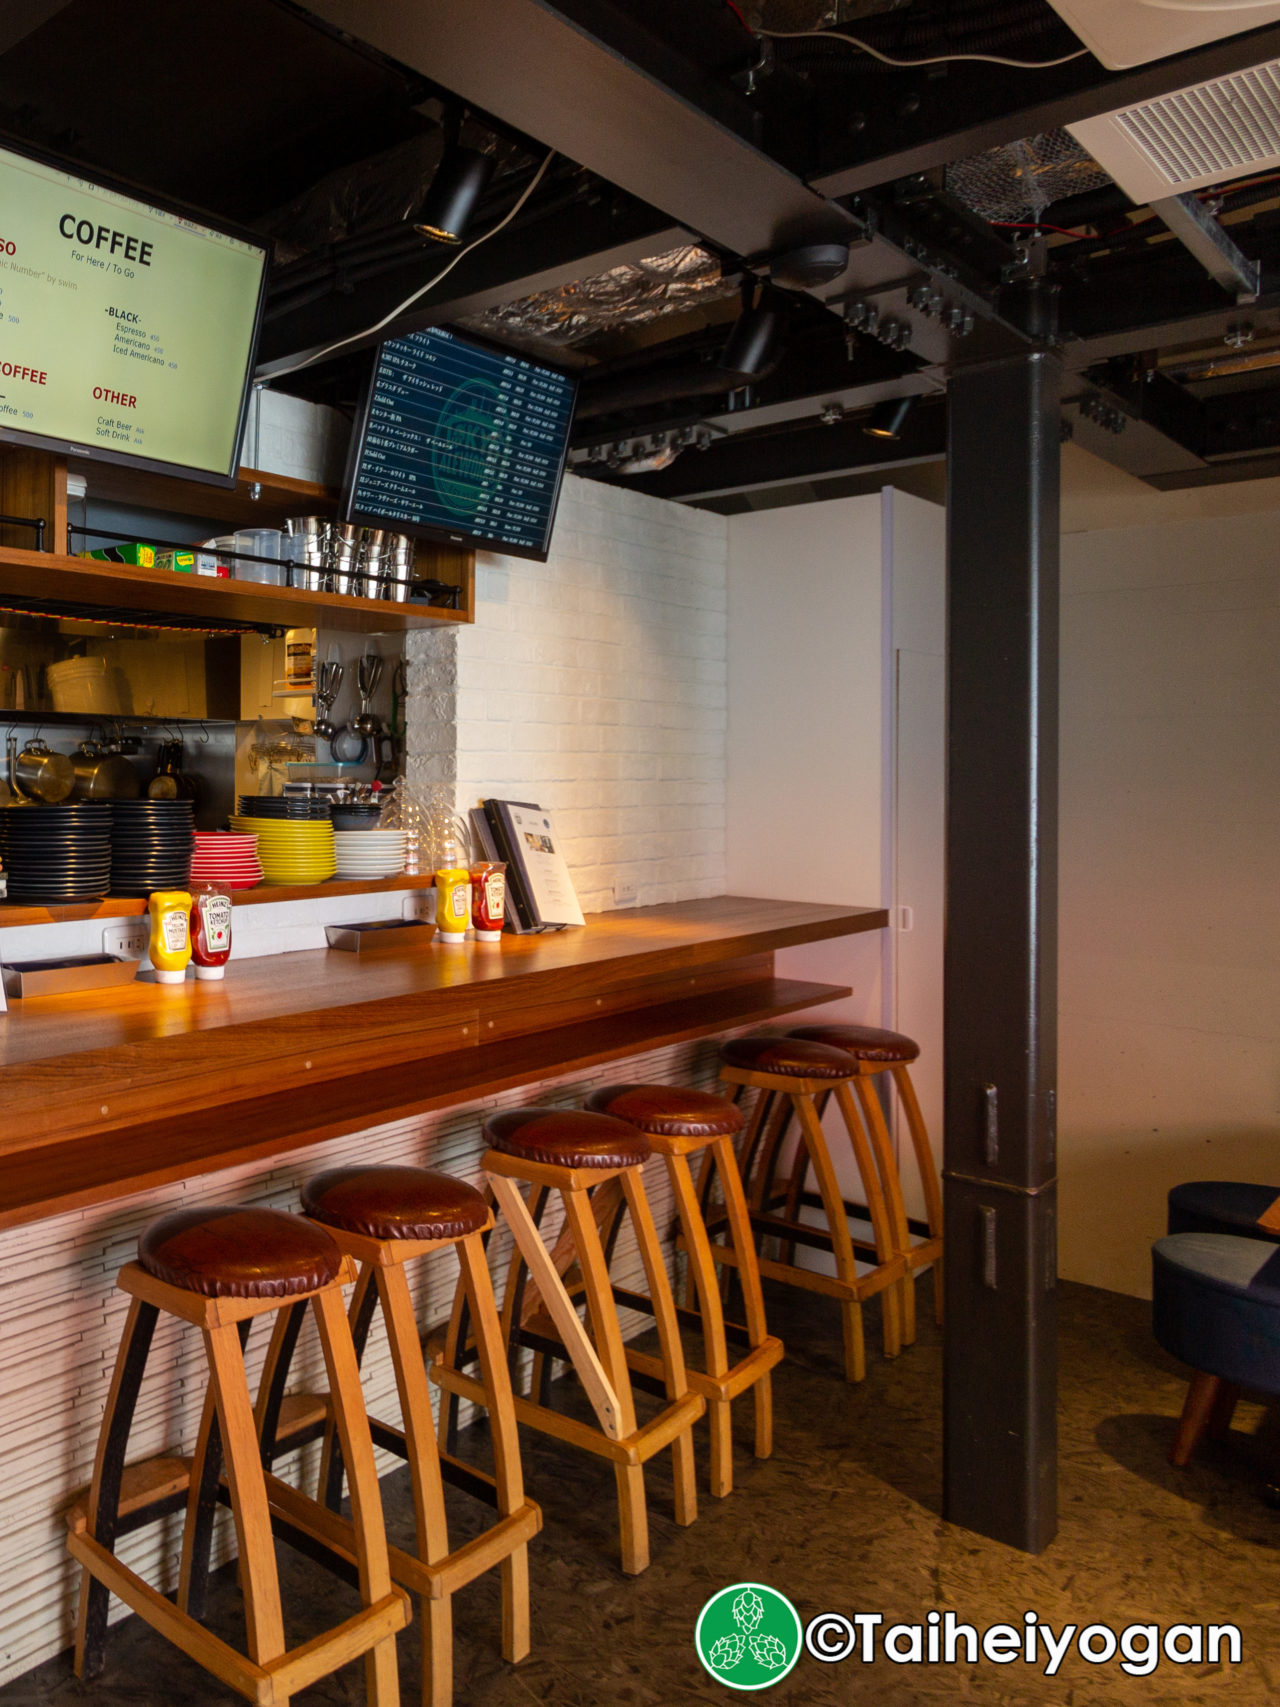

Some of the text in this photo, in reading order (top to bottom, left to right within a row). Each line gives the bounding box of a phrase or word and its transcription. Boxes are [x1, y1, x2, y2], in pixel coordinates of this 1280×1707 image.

[59, 213, 154, 267] COFFEE
[71, 249, 85, 262] For
[86, 255, 105, 269] Here
[112, 264, 123, 275] To
[124, 267, 135, 279] Go
[104, 306, 142, 324] -BLACK-
[116, 322, 147, 339] Espresso
[114, 333, 151, 351] Americano
[113, 344, 129, 357] Iced
[129, 348, 165, 367] Americano
[92, 386, 137, 409] OTHER
[97, 415, 115, 428] Craft
[116, 420, 132, 432] Beer
[96, 426, 111, 439] Soft
[112, 430, 130, 442] Drink
